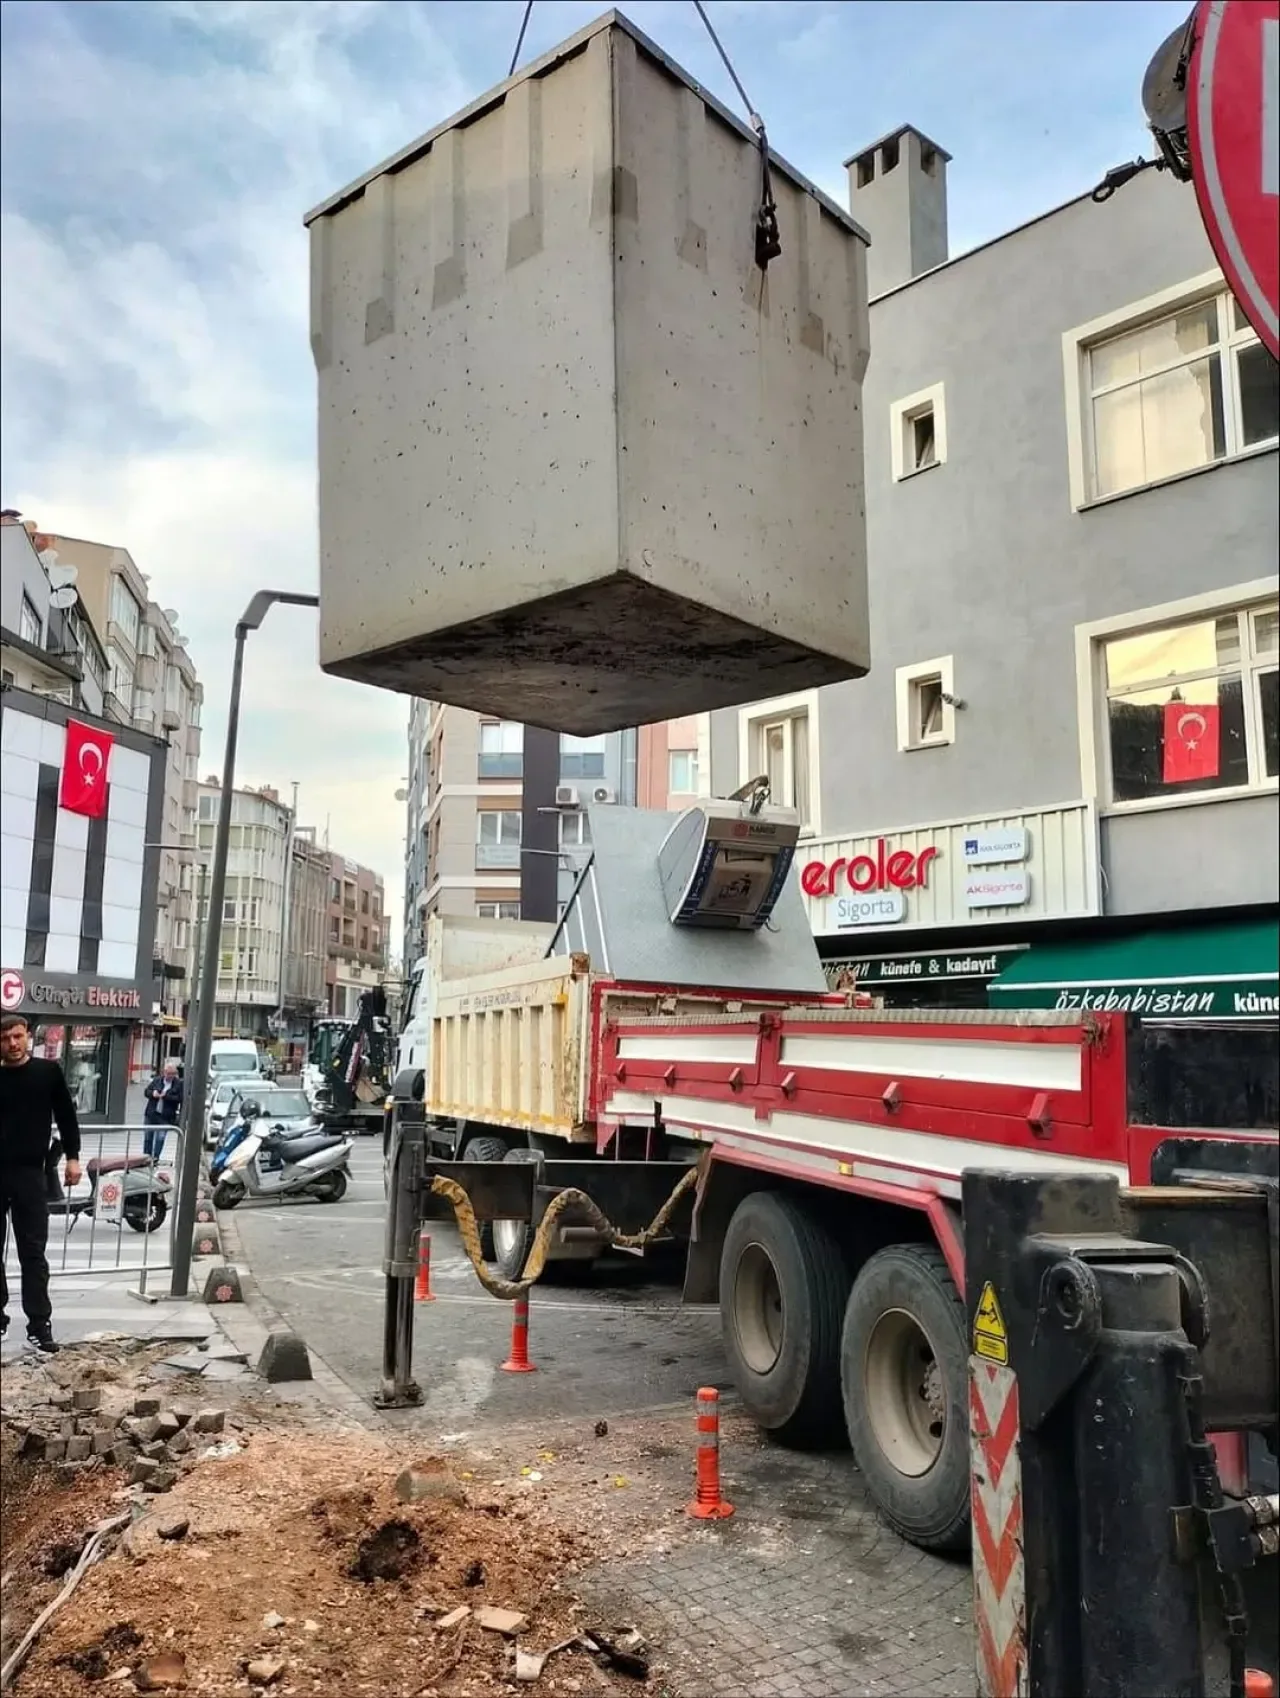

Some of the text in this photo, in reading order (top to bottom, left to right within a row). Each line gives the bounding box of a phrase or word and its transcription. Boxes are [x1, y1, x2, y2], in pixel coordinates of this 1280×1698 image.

[801, 838, 937, 897] eroler
[837, 899, 895, 921] Sigorta
[881, 960, 923, 977] künefe
[928, 959, 941, 974] &
[945, 955, 997, 974] kadayıf
[88, 986, 141, 1008] Elektrik
[1055, 987, 1215, 1013] özkebabistan
